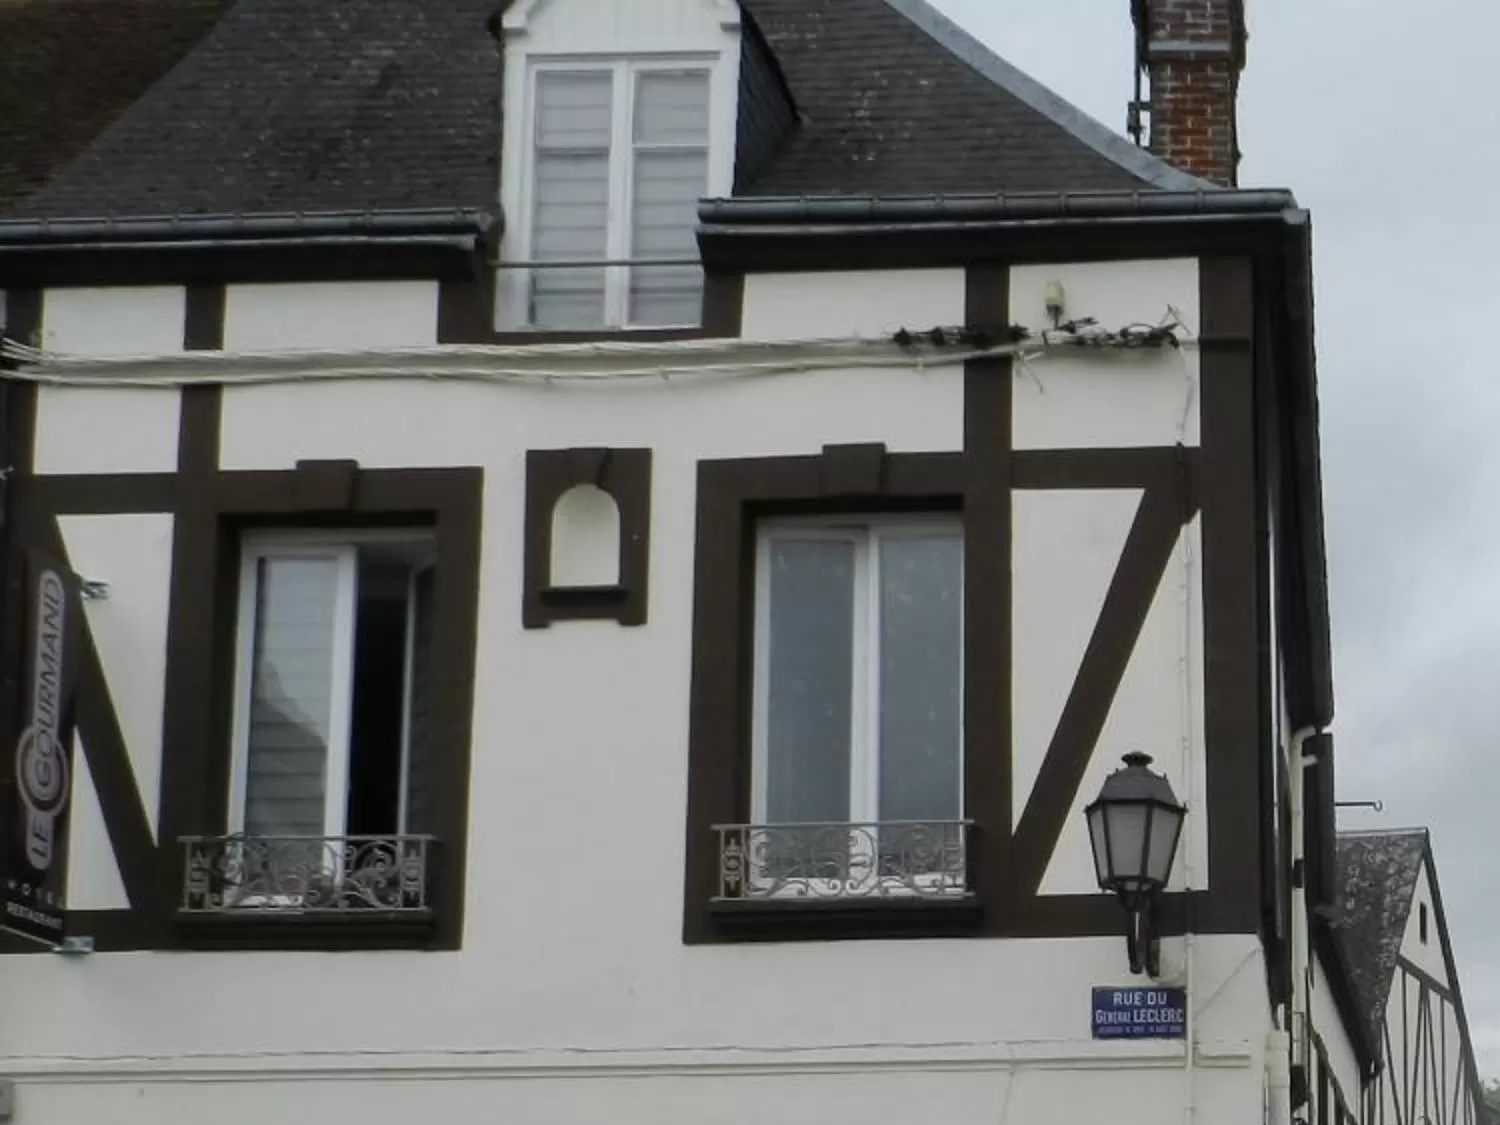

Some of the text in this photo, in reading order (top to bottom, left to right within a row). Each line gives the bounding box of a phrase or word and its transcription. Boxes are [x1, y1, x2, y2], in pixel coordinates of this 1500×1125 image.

[34, 577, 62, 788] GOURMAND
[1112, 991, 1167, 1006] RUE DU
[1133, 1007, 1184, 1023] LECLERC
